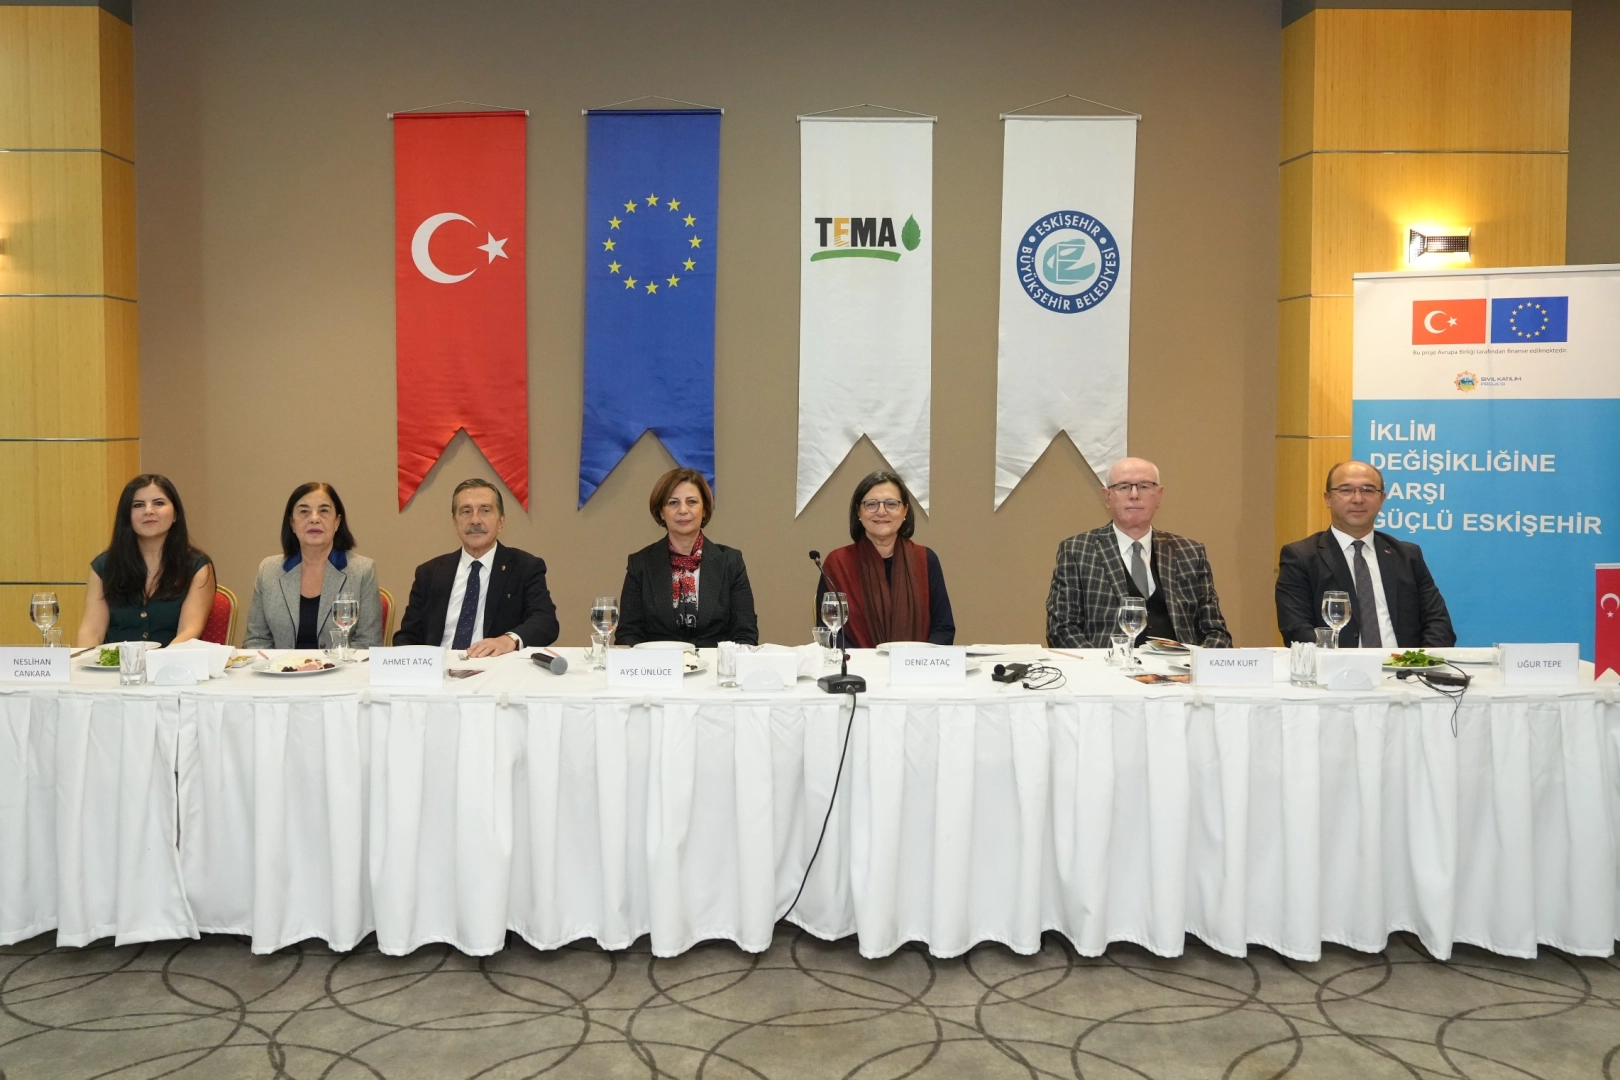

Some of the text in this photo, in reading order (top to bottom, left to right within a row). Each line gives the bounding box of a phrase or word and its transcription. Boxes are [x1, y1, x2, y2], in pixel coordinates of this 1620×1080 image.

[814, 217, 897, 248] TEMA
[1035, 213, 1100, 237] ESKİŞEHİR
[1020, 246, 1116, 310] BÜYÜKŞEHİR BELEDİYESİ
[1370, 420, 1436, 441] İKLİM
[1370, 449, 1556, 475] DEĞİŞİKLİĞİNE
[1384, 482, 1445, 505] ARŞI
[1373, 508, 1602, 537] GÜÇLÜ ESKİŞEHİR
[13, 657, 52, 667] NESLİHAN
[382, 657, 433, 668] AHMET ATAÇ
[904, 657, 950, 668] DENİZ ATAÇ
[1209, 659, 1259, 667] KAZIM KURT
[1517, 659, 1562, 669] UĞUR TEPE
[14, 669, 51, 678] CANKARA
[620, 666, 672, 677] AYŞE ÜNLÜCE
